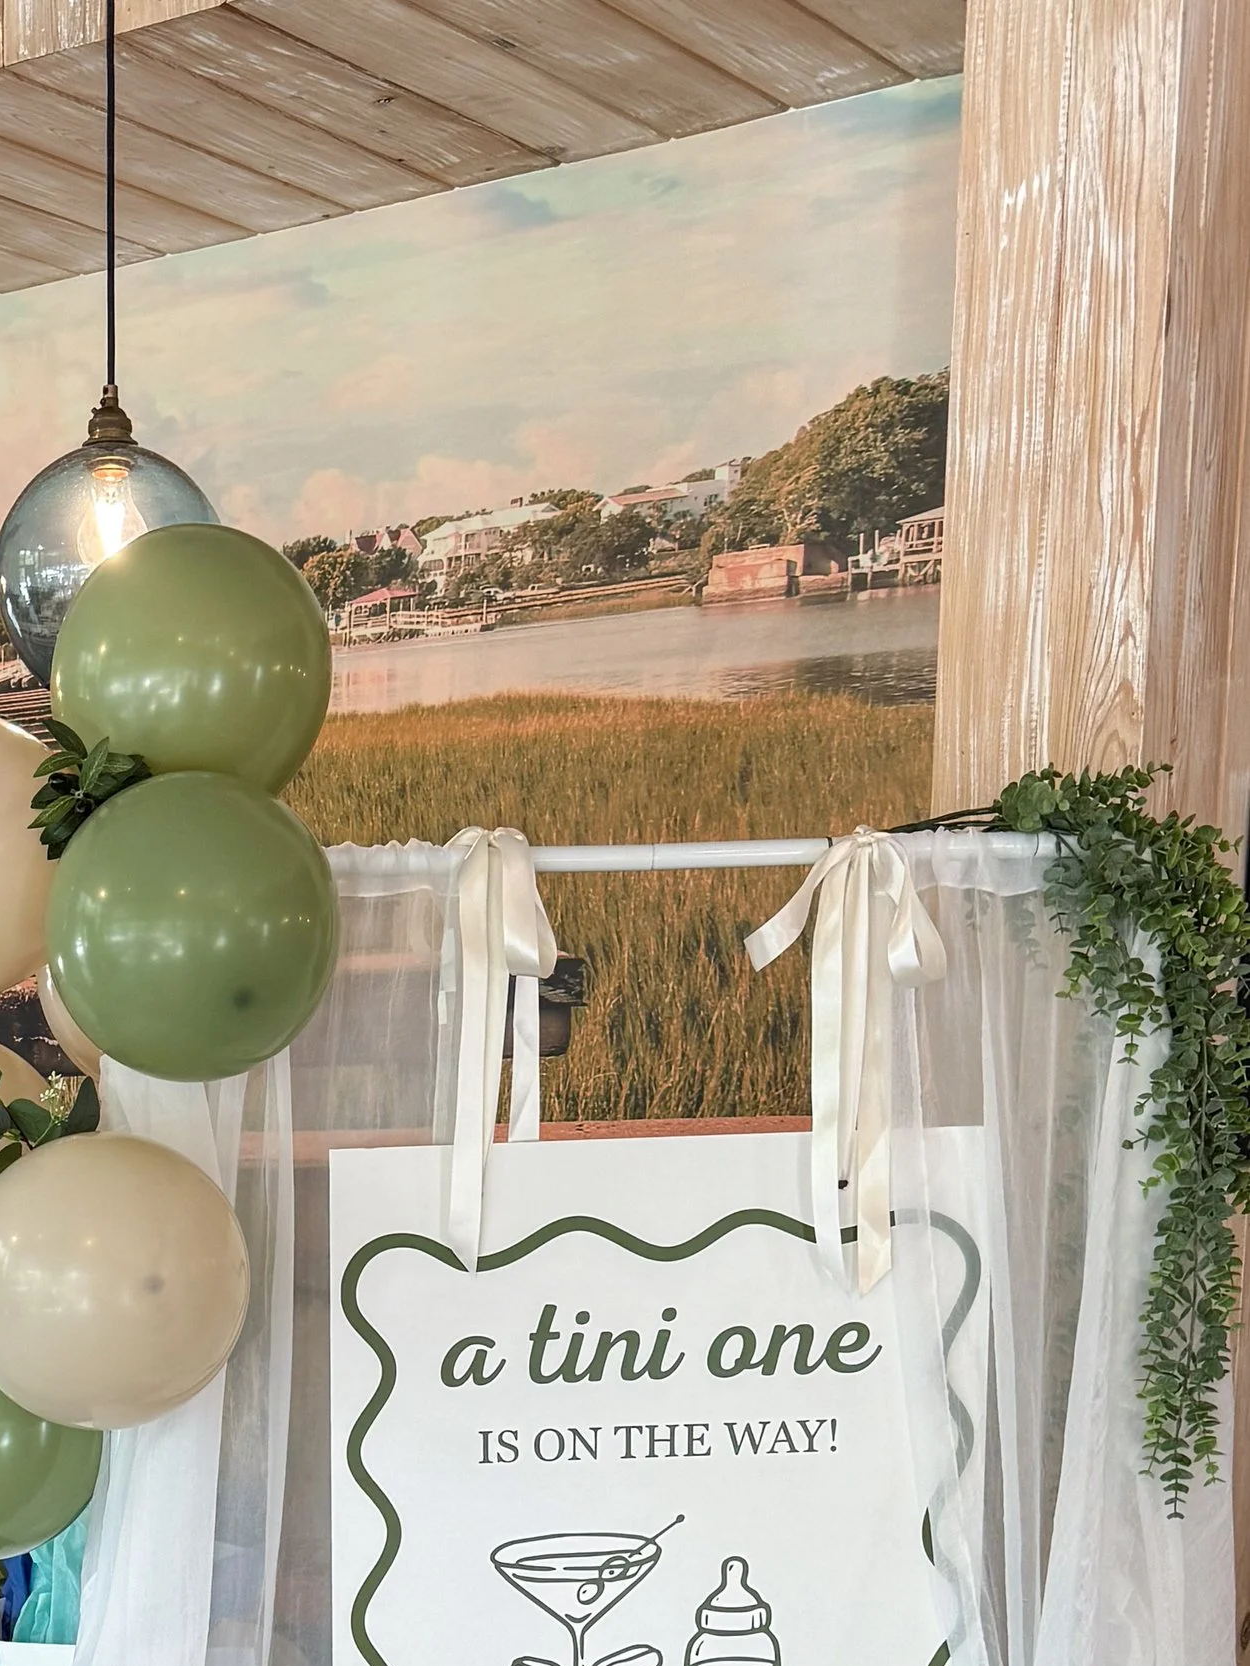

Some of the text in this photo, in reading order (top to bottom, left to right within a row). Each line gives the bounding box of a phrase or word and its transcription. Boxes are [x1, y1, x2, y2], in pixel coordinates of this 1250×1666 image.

[440, 1303, 883, 1388] a tini one
[478, 1418, 837, 1464] IS ON THE WAY!
